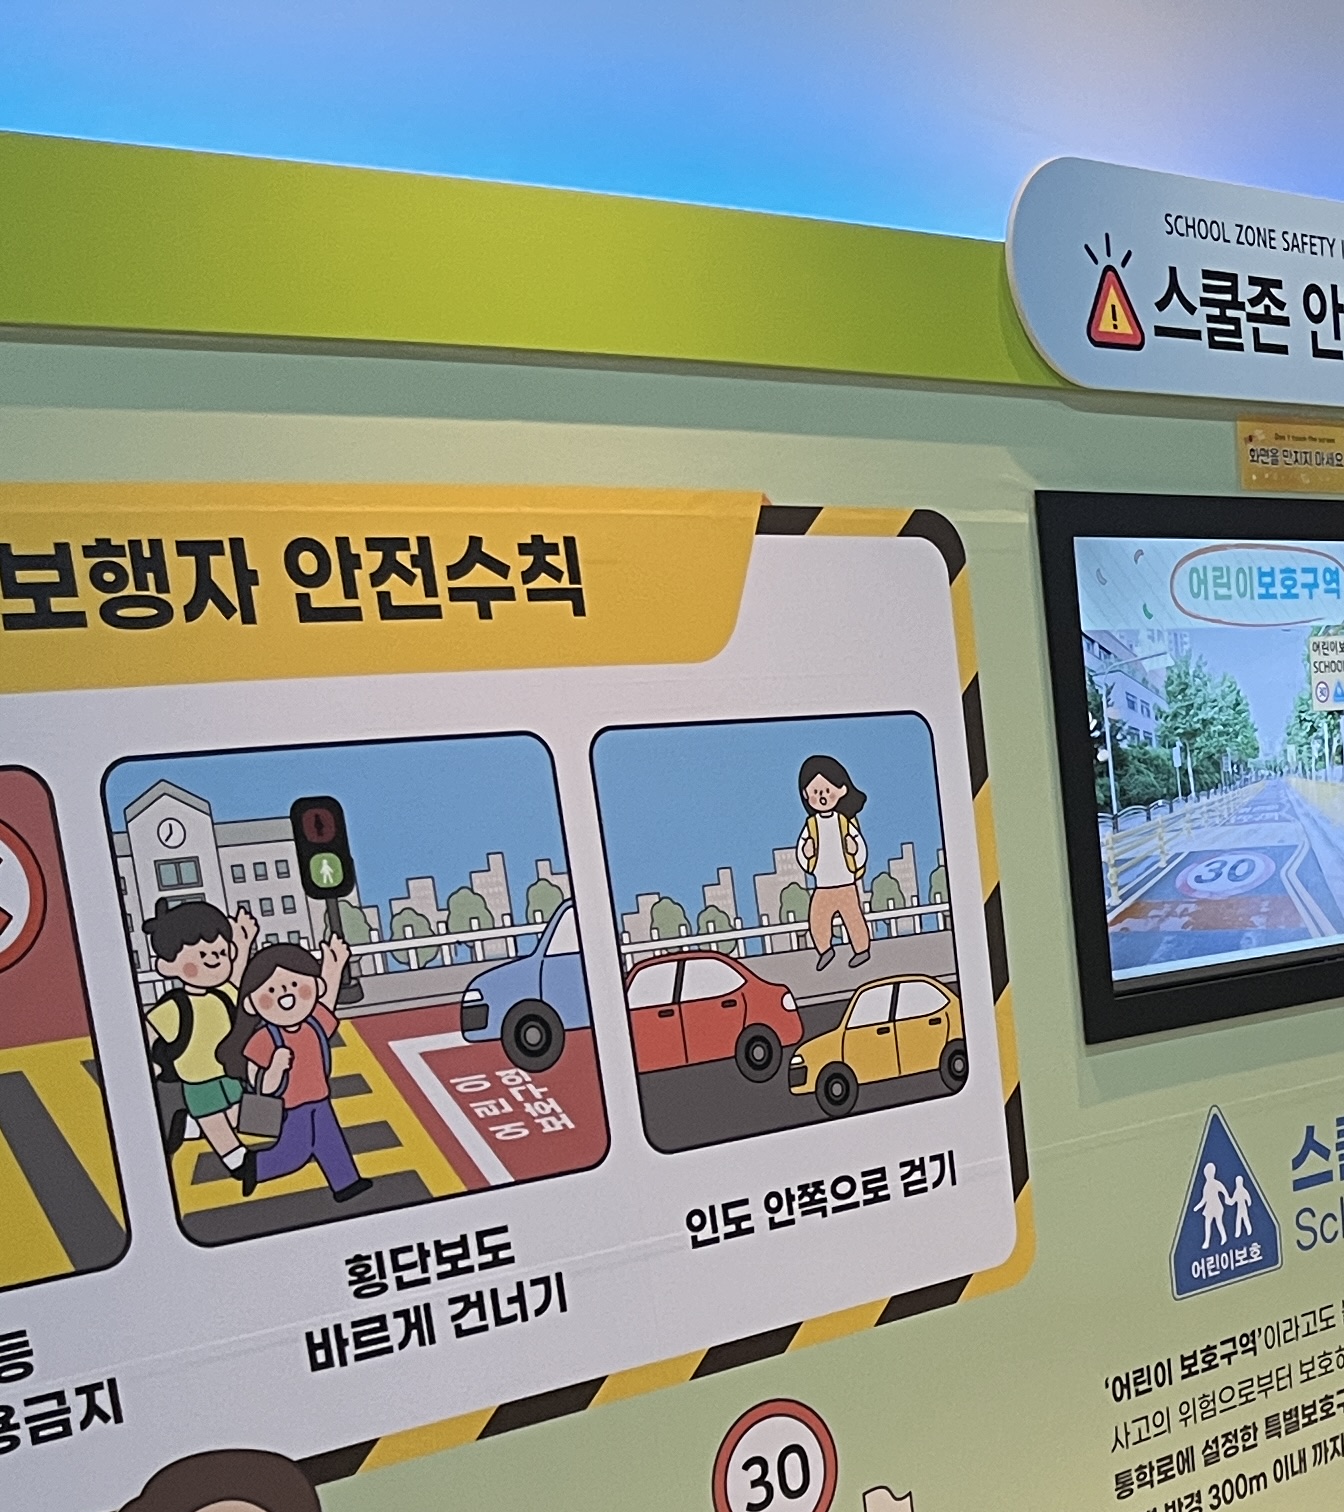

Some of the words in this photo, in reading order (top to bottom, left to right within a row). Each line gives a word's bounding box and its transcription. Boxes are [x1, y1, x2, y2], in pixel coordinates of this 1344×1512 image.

[1164, 213, 1231, 243] SCHOOL
[1235, 223, 1276, 250] ZONE
[1282, 230, 1336, 258] SAFETY
[1153, 265, 1291, 356] 스쿨존
[1249, 447, 1279, 466] 화면을
[1282, 448, 1312, 467] 만지지
[1314, 450, 1344, 469] 마세요
[0, 537, 259, 631] 보행자
[283, 534, 587, 624] 안전수칙
[1188, 565, 1341, 600] 어린이보호구역
[1193, 858, 1256, 885] 30
[685, 1198, 755, 1250] 인도
[763, 1166, 891, 1231] 안쪽으로
[898, 1150, 958, 1198] 걷기
[344, 1225, 516, 1300] 횡단보도
[1190, 1242, 1263, 1281] 어린이보호
[305, 1302, 437, 1373] 바르게
[447, 1271, 568, 1339] 건너기
[1110, 1405, 1172, 1454] 사고의
[1178, 1363, 1293, 1428] 위험으로부터
[741, 1443, 811, 1512] 30
[1114, 1445, 1196, 1500] 통학로에
[1201, 1421, 1259, 1468] 설정한
[1207, 1471, 1268, 1512] 300m
[1272, 1447, 1308, 1484] 이내
